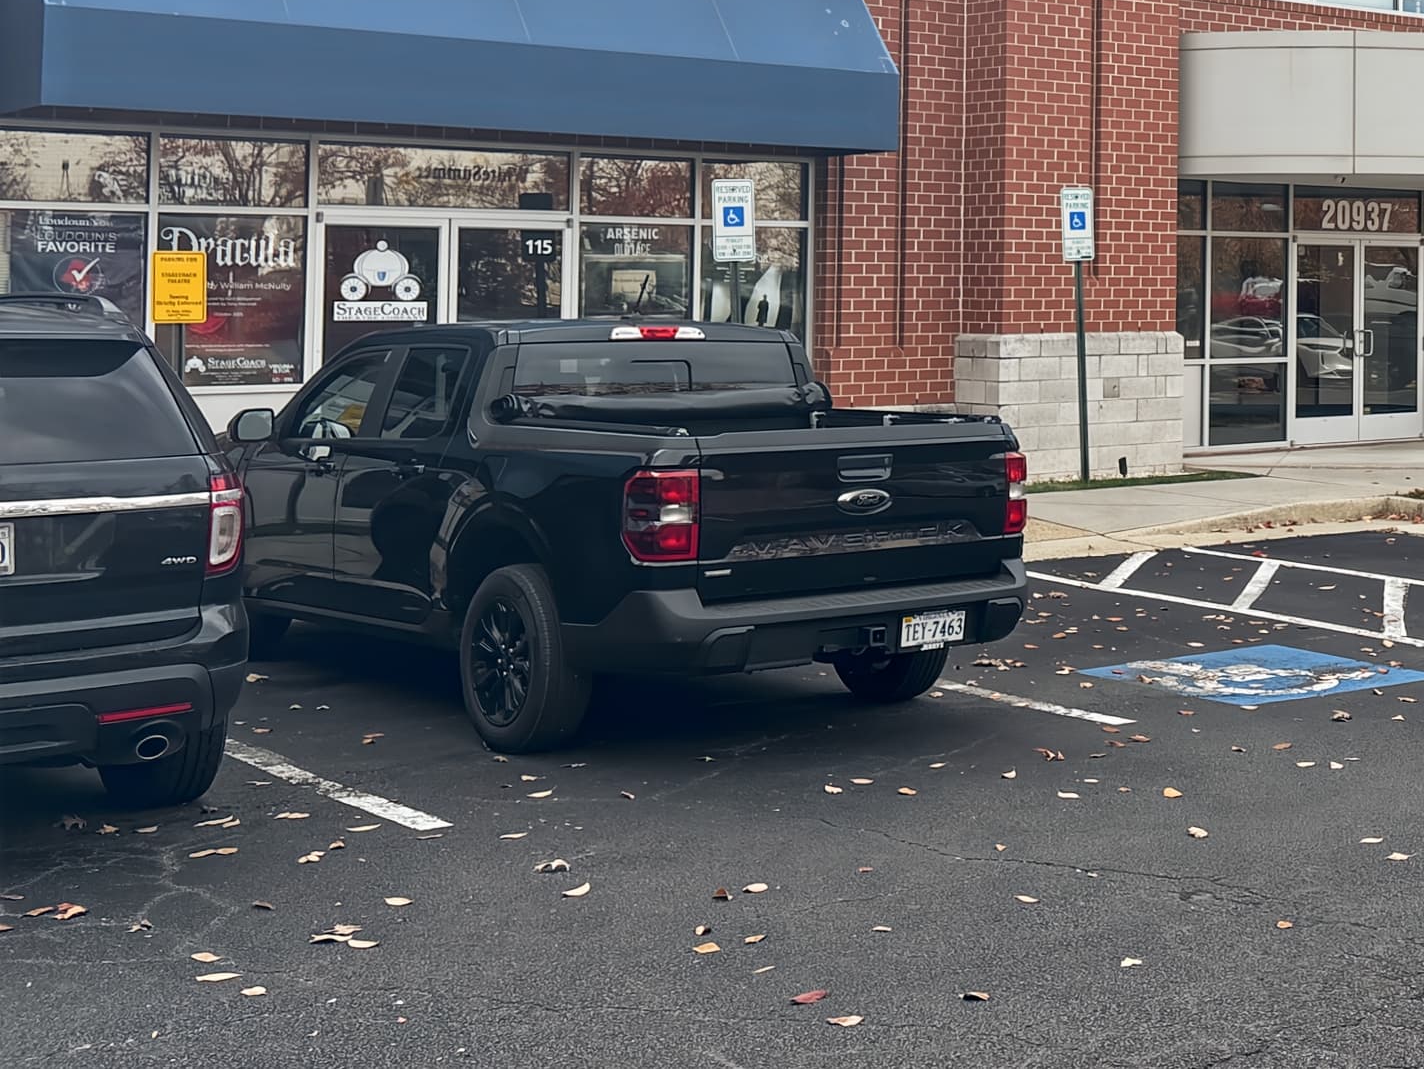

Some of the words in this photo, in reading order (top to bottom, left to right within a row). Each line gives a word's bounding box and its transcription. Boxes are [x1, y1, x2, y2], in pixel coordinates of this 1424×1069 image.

[39, 216, 89, 226] Loudoun
[1322, 199, 1392, 231] 20937
[37, 231, 117, 241] LOUDOUN'S
[606, 227, 659, 240] ARSENIC
[38, 241, 116, 253] FAVORITE
[160, 226, 296, 267] Dracula
[526, 239, 552, 255] 115
[254, 282, 292, 290] McNulty
[161, 556, 197, 565] 4WD
[905, 618, 963, 642] TEY-7463
